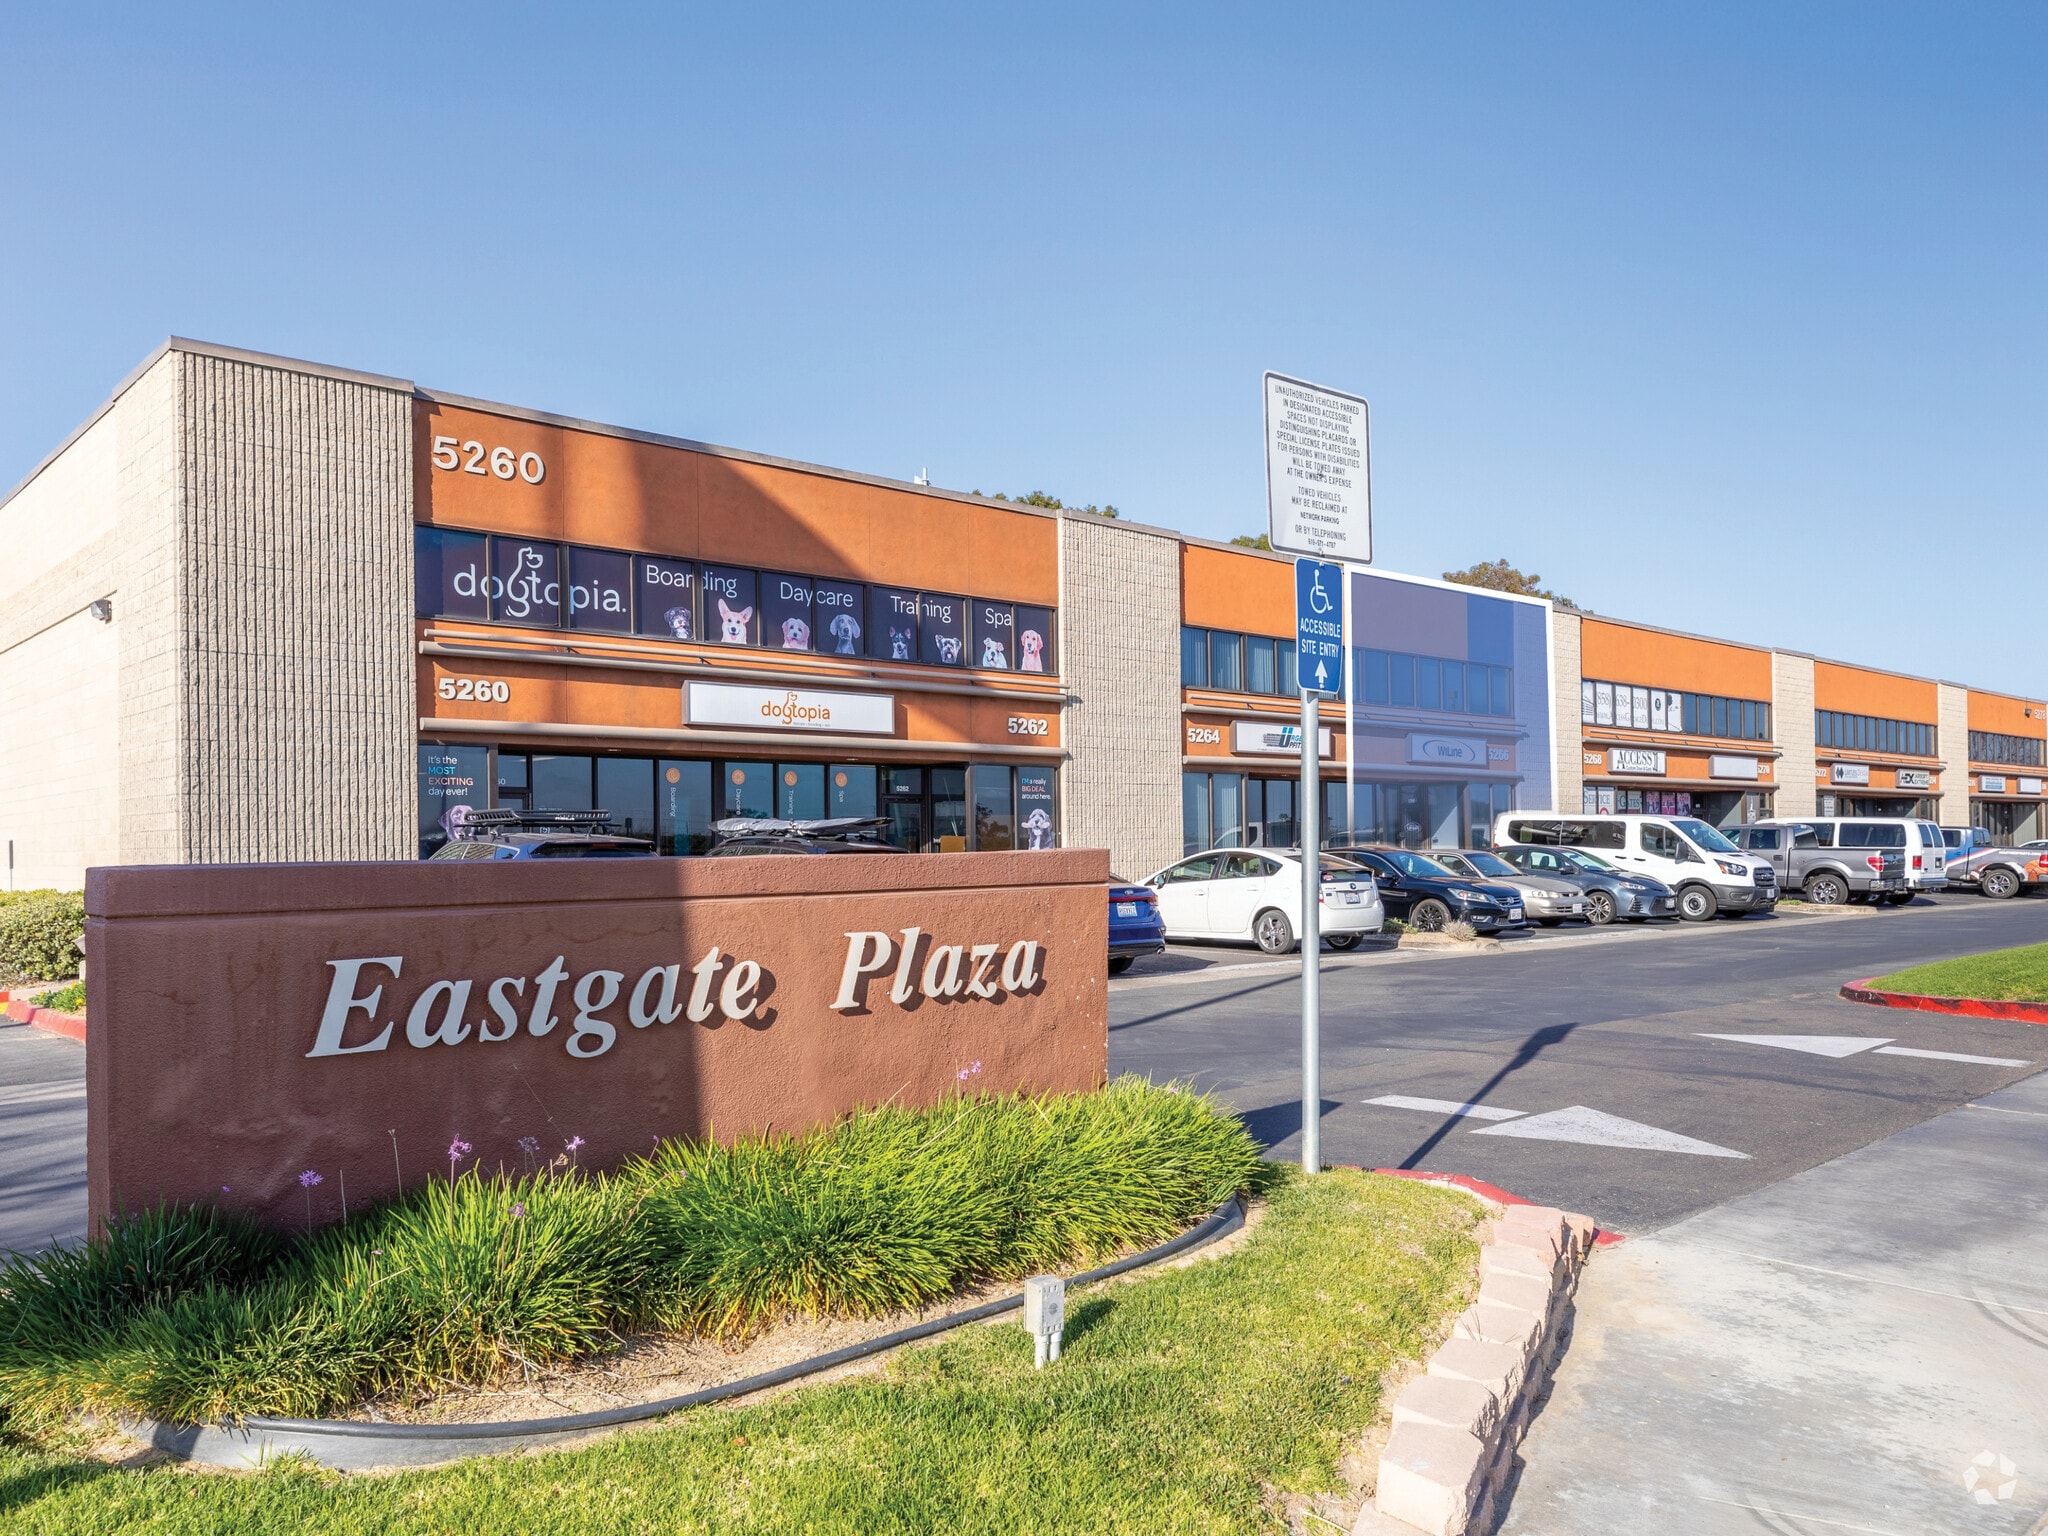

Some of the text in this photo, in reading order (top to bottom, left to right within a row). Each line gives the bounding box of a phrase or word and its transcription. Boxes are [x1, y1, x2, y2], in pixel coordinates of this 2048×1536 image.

[1274, 384, 1359, 415] UNAUTHORIZED VEHICLES PARKED
[1283, 398, 1352, 424] IN DESIGNATED ACCESSIBLE
[1287, 411, 1349, 434] SPACES NOT DISPLAYING
[1280, 420, 1357, 446] DISTINGUISHING PLACARDS OR
[1277, 431, 1360, 458] SPECIAL LICENSE PLATES ISSUED
[432, 435, 546, 484] 5260
[1278, 442, 1360, 468] FOR PERSONS WITH DISABILITIES
[1292, 457, 1345, 476] WILL BE TOWED AWAY
[1287, 467, 1293, 475] AT
[1294, 469, 1303, 479] THE
[1329, 476, 1352, 488] EXPENSE
[1298, 486, 1341, 502] TOWED VEHICLES
[1292, 496, 1302, 505] MAY
[1303, 498, 1310, 507] BE
[1312, 500, 1340, 513] RECLAIMED
[1300, 512, 1339, 524] NETWORK PARKING
[1295, 524, 1346, 541] OR BY TELEPHONING
[646, 564, 738, 599] Boarding
[890, 595, 952, 624] Training
[985, 608, 1012, 629] Spa
[1300, 618, 1341, 638] ACCESSIBLE
[1302, 639, 1339, 657] SITE ENTRY
[438, 678, 509, 703] 5260
[761, 691, 831, 724] dogtopia
[1008, 717, 1048, 736] 5262
[1188, 727, 1220, 744] 5264
[428, 755, 458, 765] It's the
[1438, 745, 1462, 757] WiLine
[1488, 748, 1509, 760] 5266
[1583, 753, 1602, 765] 5268
[1616, 751, 1653, 769] ACCESS
[428, 766, 456, 775] MOST
[1757, 765, 1770, 774] 270
[428, 777, 473, 786] EXCITING
[1034, 778, 1047, 786] really
[428, 787, 468, 797] day ever!
[305, 926, 1040, 1058] Eastgate Plaza
